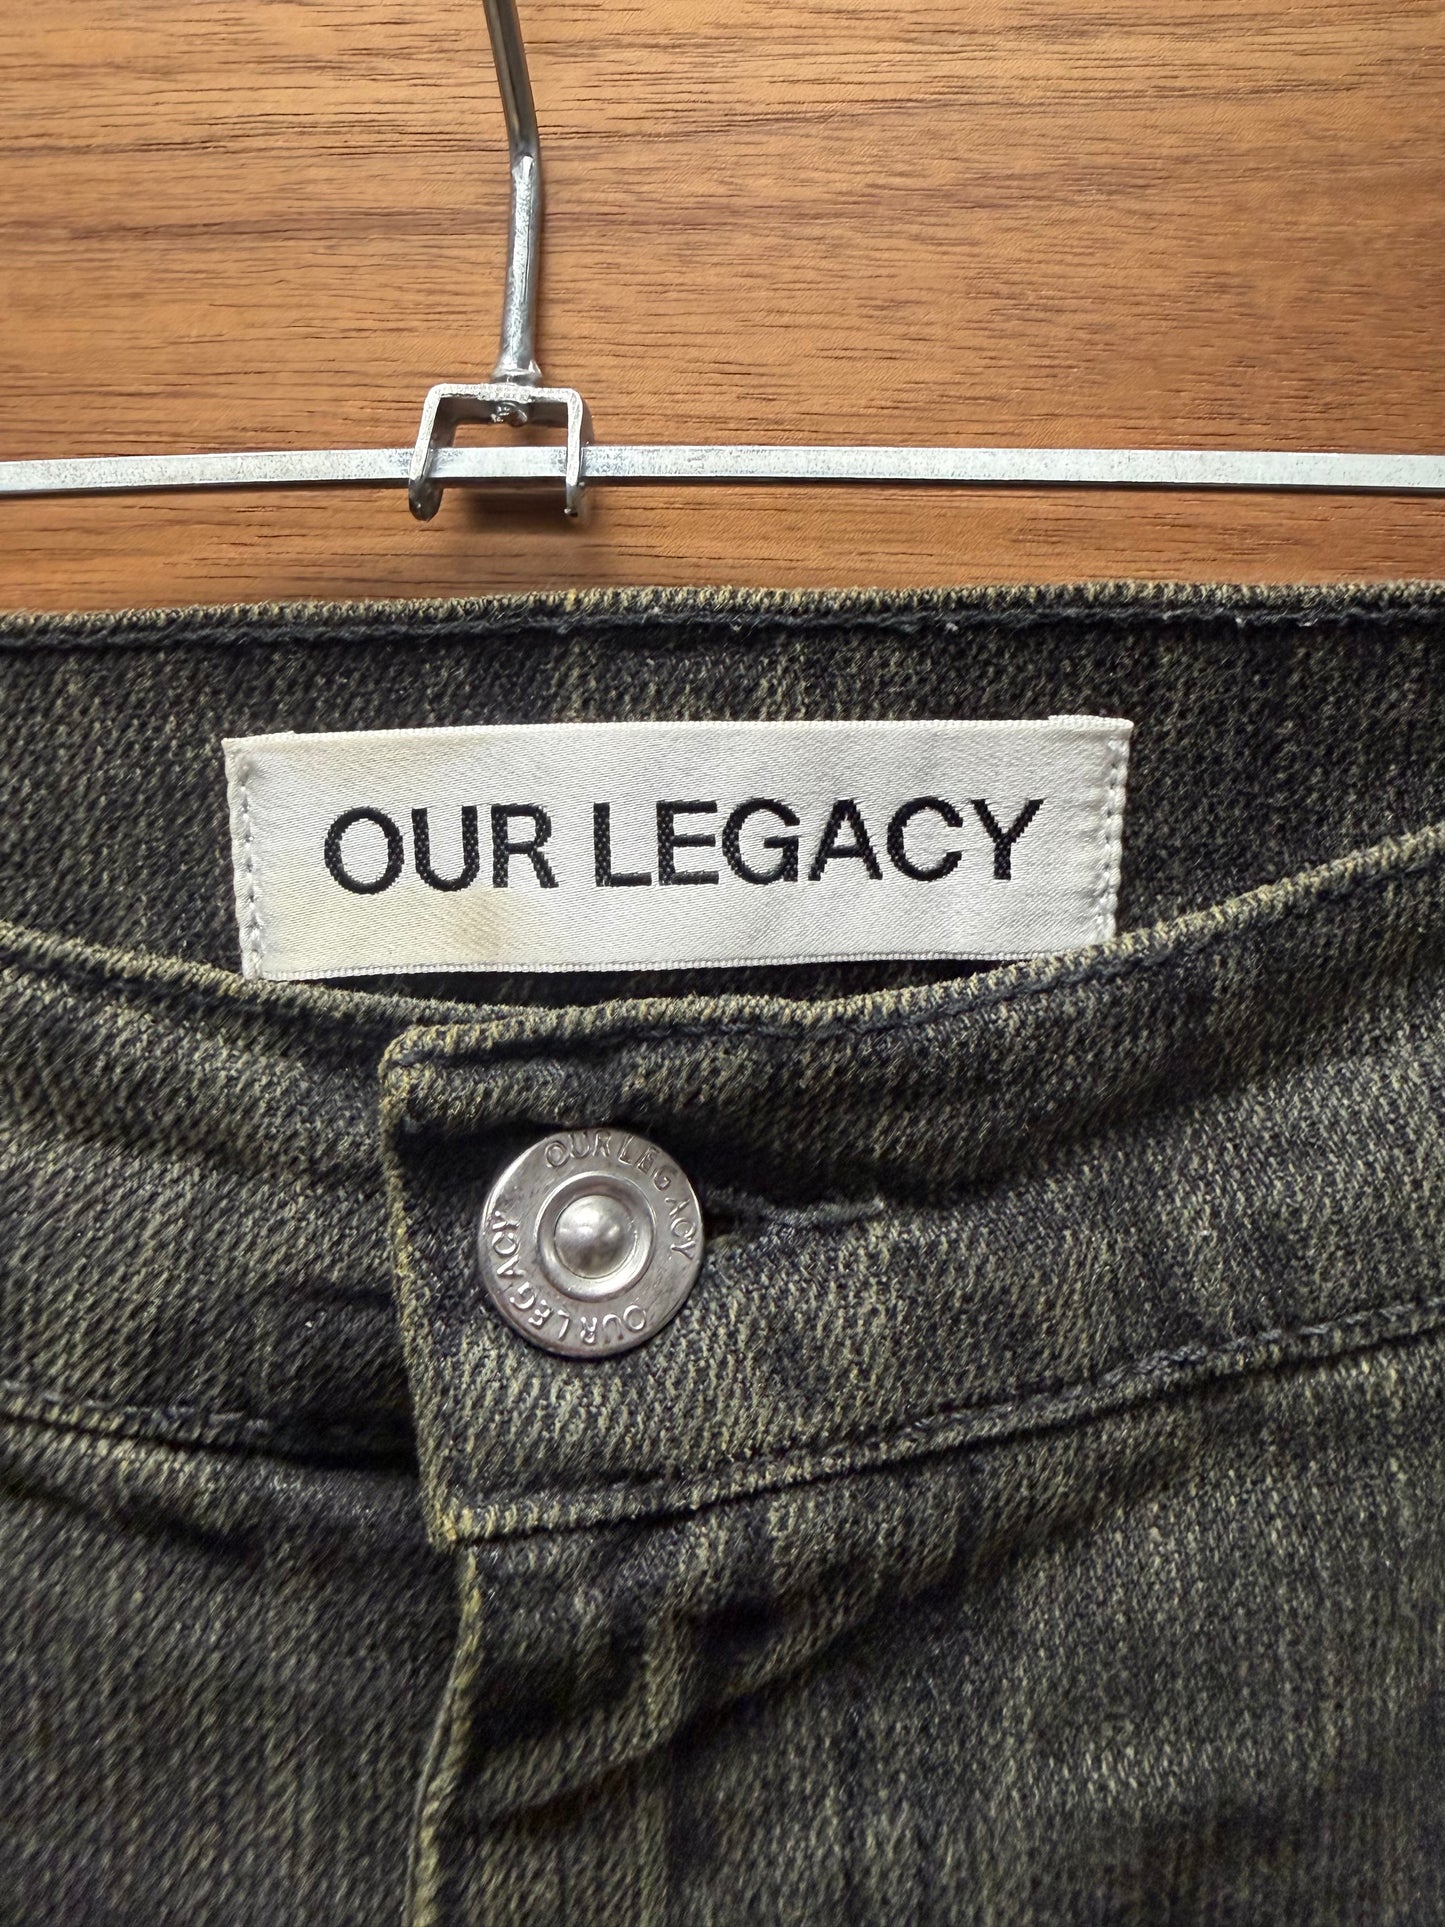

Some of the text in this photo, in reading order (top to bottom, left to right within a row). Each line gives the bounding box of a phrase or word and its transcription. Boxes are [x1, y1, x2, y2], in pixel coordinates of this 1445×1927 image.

[323, 795, 1046, 896] OUR LEGACY
[544, 1130, 697, 1261] OUR LEGACY
[491, 1210, 647, 1345] OUR LEGACY
